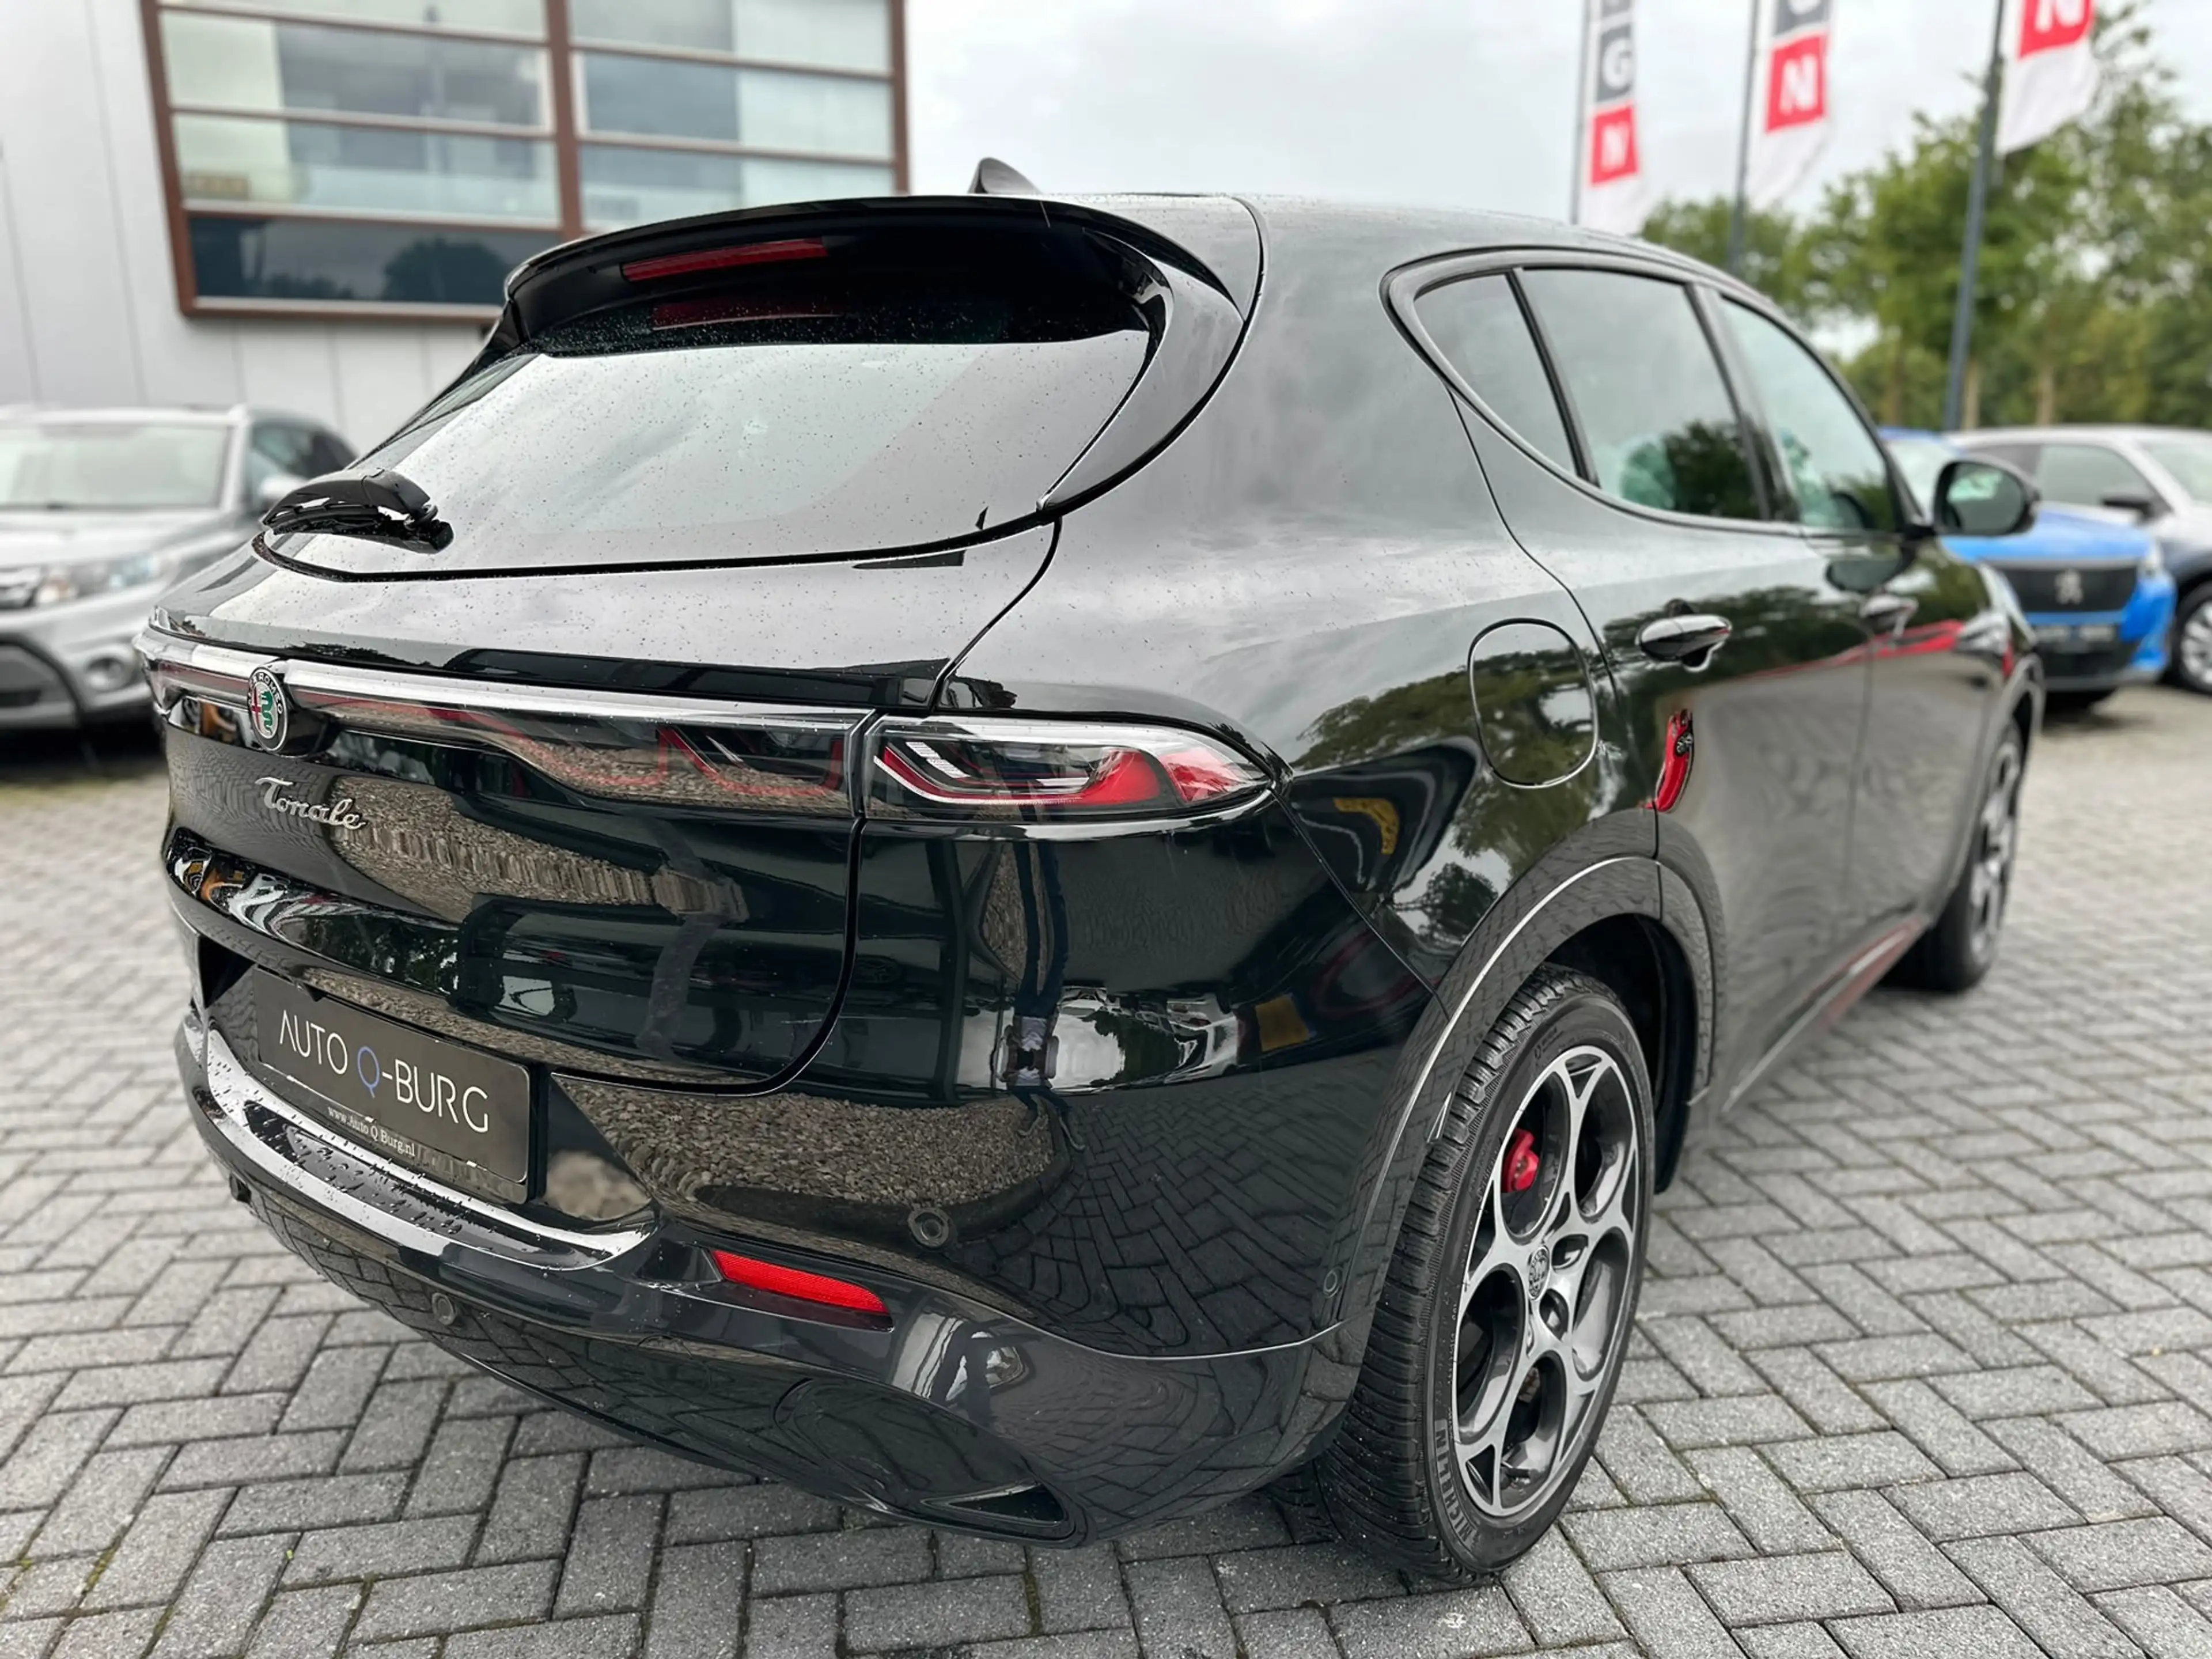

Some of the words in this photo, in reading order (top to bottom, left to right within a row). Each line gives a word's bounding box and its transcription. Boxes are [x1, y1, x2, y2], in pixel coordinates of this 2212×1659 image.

[255, 776, 368, 830] Tonale
[279, 1009, 348, 1075] AUTO
[1435, 1424, 1474, 1544] MICHELIN
